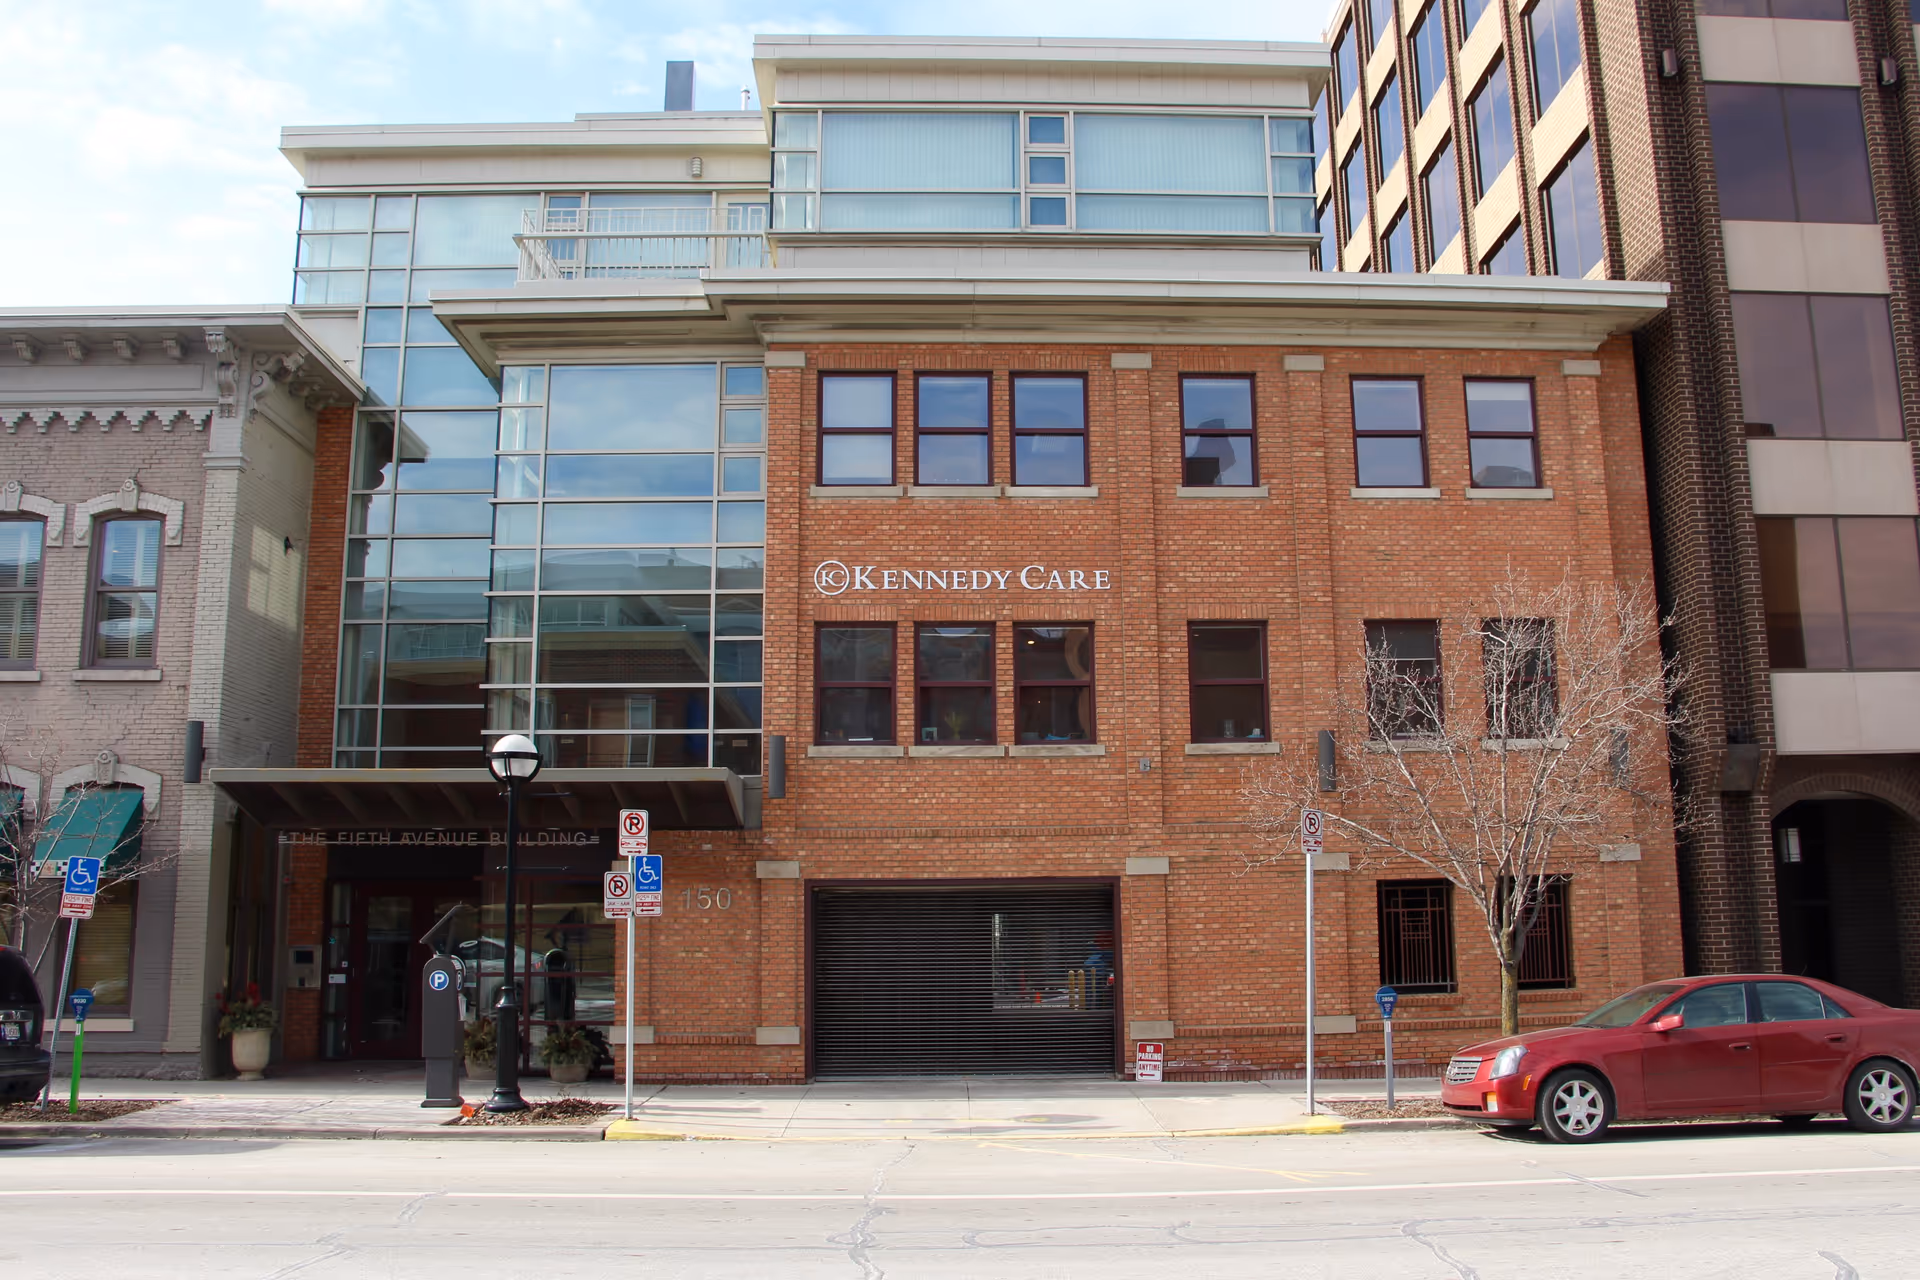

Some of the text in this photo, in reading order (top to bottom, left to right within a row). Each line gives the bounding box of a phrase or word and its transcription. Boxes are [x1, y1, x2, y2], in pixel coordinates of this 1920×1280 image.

[852, 565, 1012, 590] KENNEDY
[1020, 565, 1111, 590] CARE
[289, 832, 327, 846] THE
[338, 832, 391, 846] FIFTH
[399, 832, 478, 846] AVENUE
[682, 887, 731, 910] 150
[434, 973, 445, 987] P
[1138, 1052, 1162, 1060] PARKING
[1146, 1045, 1155, 1053] NO
[1138, 1063, 1161, 1071] ANYTIME
